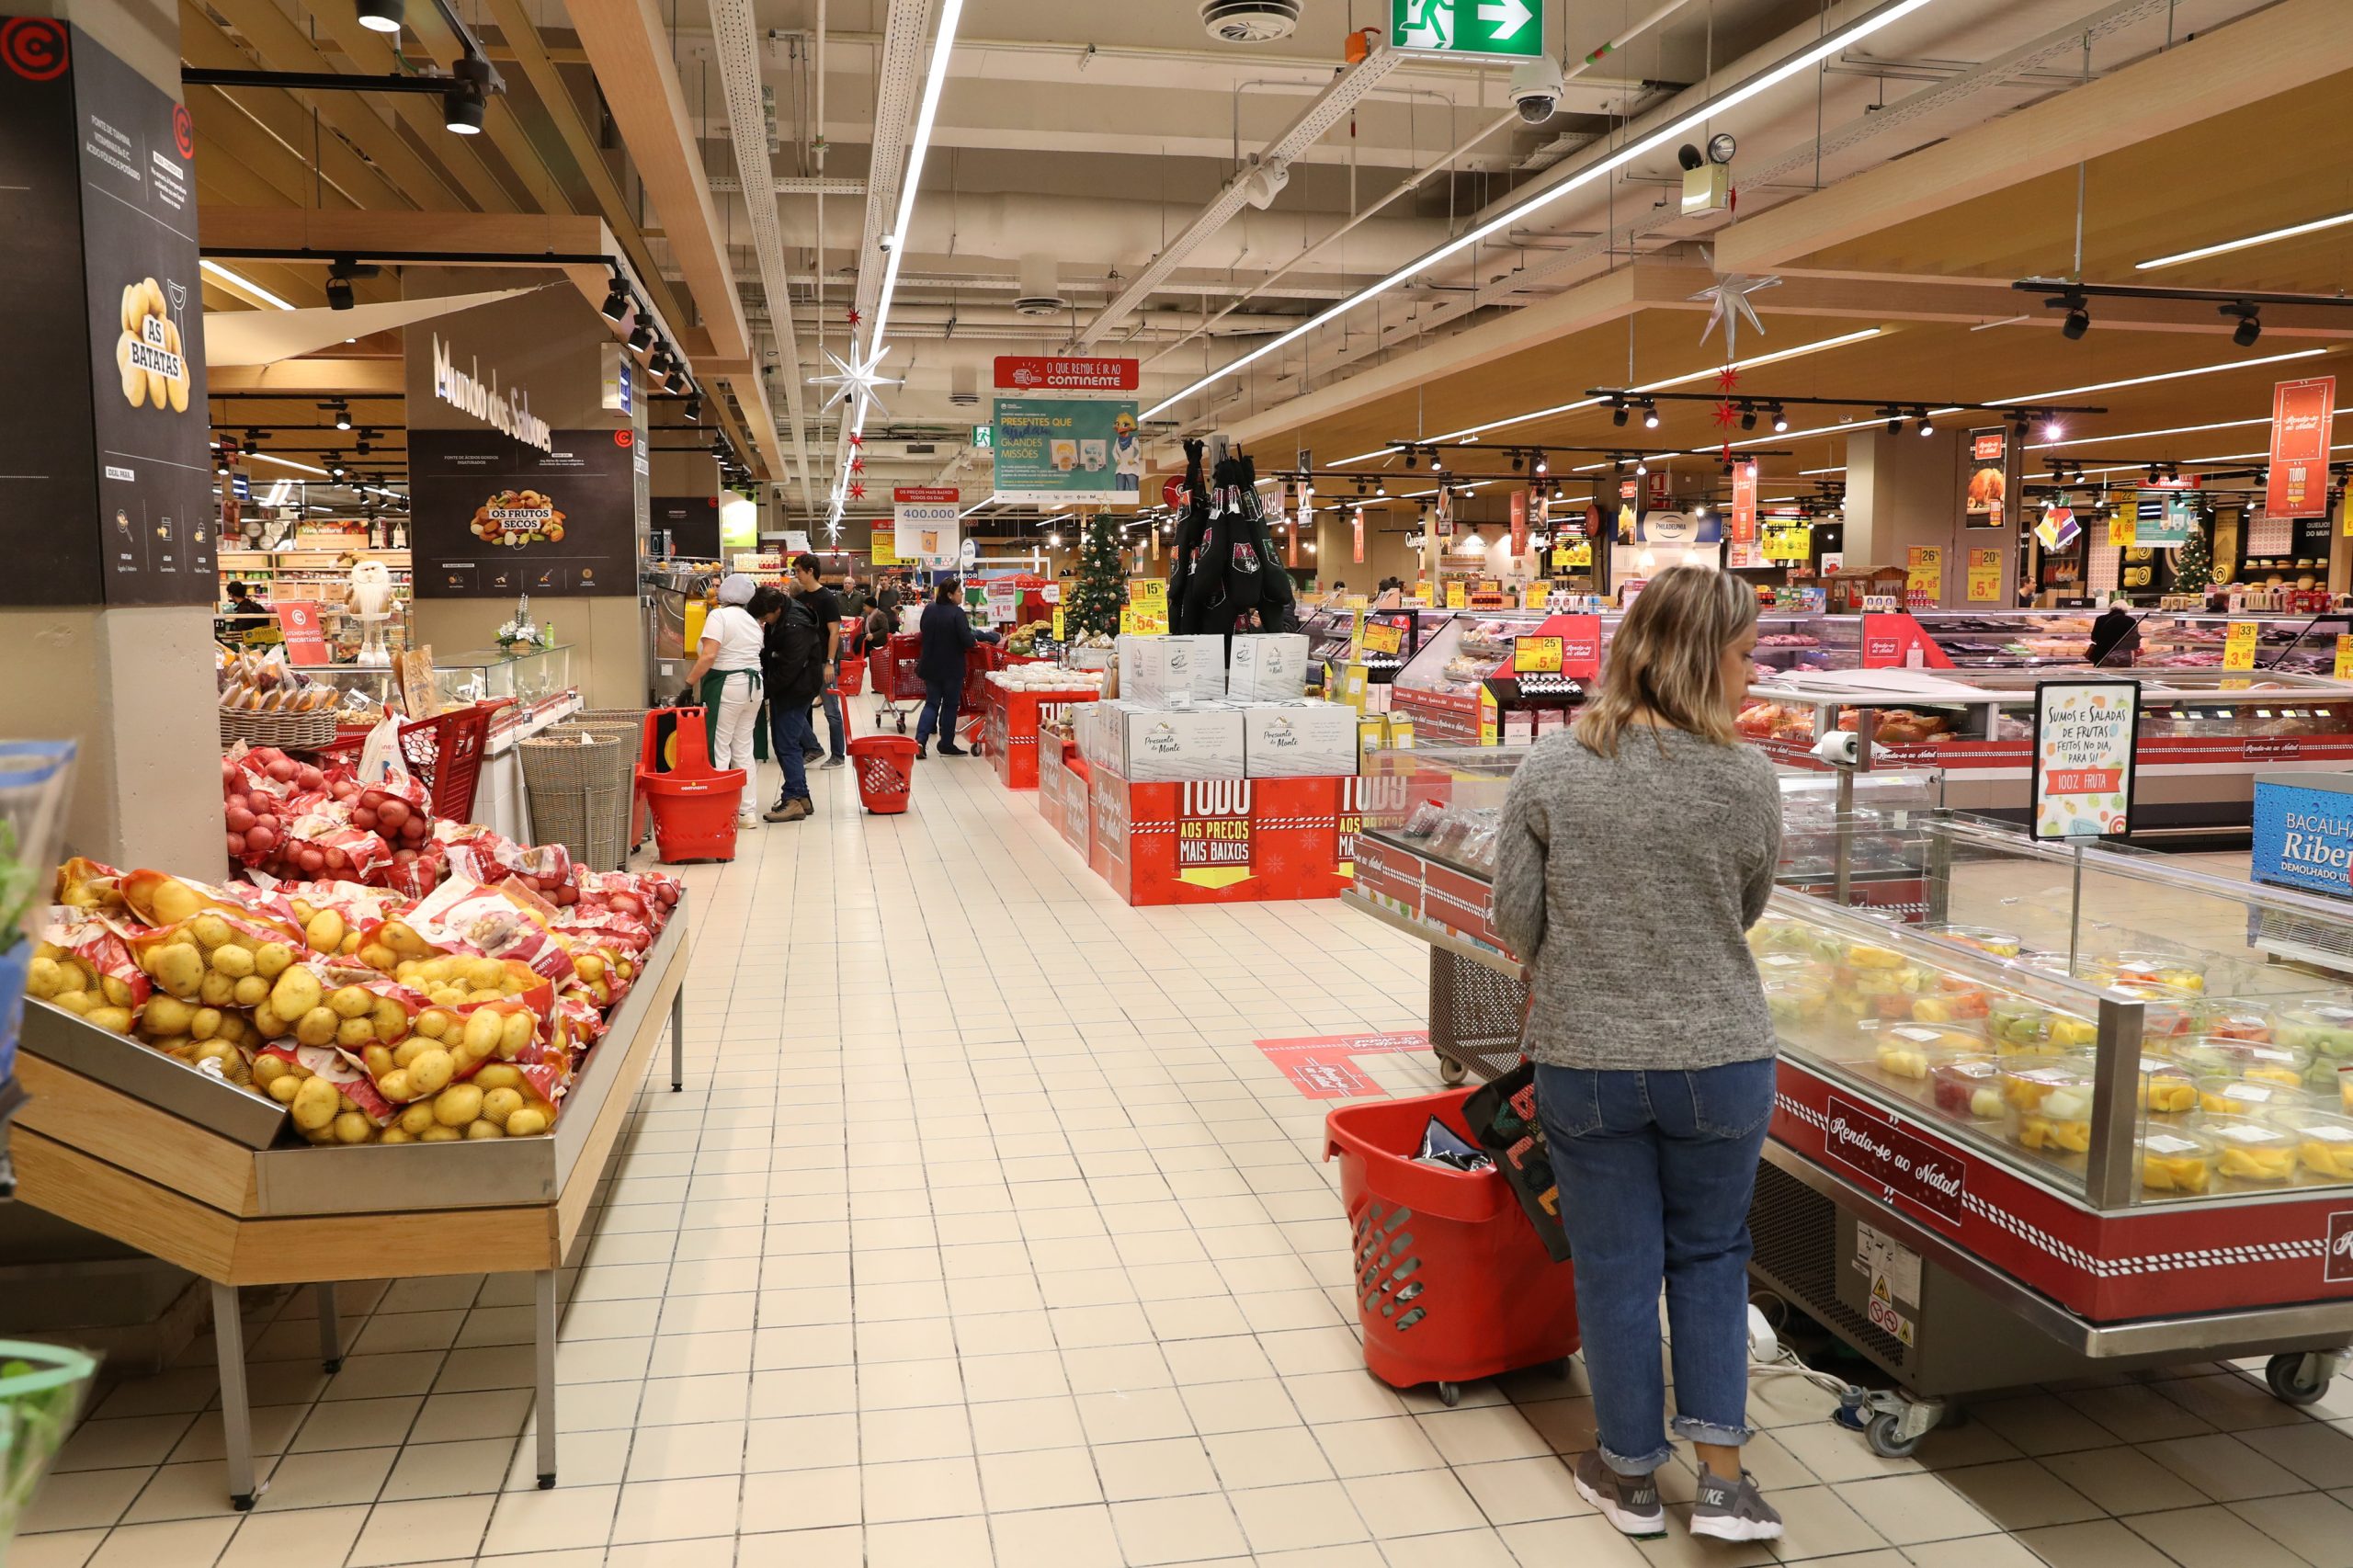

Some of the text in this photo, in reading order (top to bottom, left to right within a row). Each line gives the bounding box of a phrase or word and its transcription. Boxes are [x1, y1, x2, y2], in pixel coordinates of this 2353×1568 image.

[148, 318, 163, 344] AS
[131, 344, 179, 378] BATATAS
[1047, 361, 1121, 375] O QUE RENDE É IR AO
[432, 332, 487, 421] Mundo
[1047, 376, 1120, 386] CONTINENTE
[1000, 416, 1073, 427] PRESENTES QUE
[1000, 437, 1043, 448] GRANDES
[1000, 449, 1039, 459] MISSÕES
[2289, 467, 2307, 483] TUDO
[492, 509, 550, 517] OS FRUTOS
[904, 509, 955, 518] 400.000
[504, 520, 538, 528] SECOS
[1655, 522, 1687, 531] PHILADELPHIA
[1405, 531, 1429, 554] Queijos
[1145, 583, 1163, 595] 15%
[2240, 625, 2256, 636] 33%
[288, 635, 322, 643] PRIORITÁRIO
[1544, 638, 1560, 648] 25%
[1565, 644, 1592, 653] Renda-se
[2048, 706, 2126, 724] SUMOS E SALADAS
[1264, 730, 1292, 740] Presunto
[2063, 725, 2109, 739] DE FRUTAS
[1144, 736, 1174, 746] Presunto
[1277, 738, 1299, 748] Monte
[2057, 741, 2112, 752] FEITOS NO DIA,
[1158, 743, 1181, 754] Monte
[2068, 754, 2086, 764] PARA
[2058, 774, 2107, 790] 100% FRUTA
[1183, 780, 1251, 815] TUDO
[1180, 821, 1249, 840] AOS PREÇOS
[1339, 818, 1360, 833] AOS
[1180, 841, 1249, 861] MAIS BAIXOS
[1338, 835, 1354, 856] MA
[2281, 862, 2336, 880] DEMOLHADO
[1830, 1117, 1961, 1198] Renda-se ao Natal
